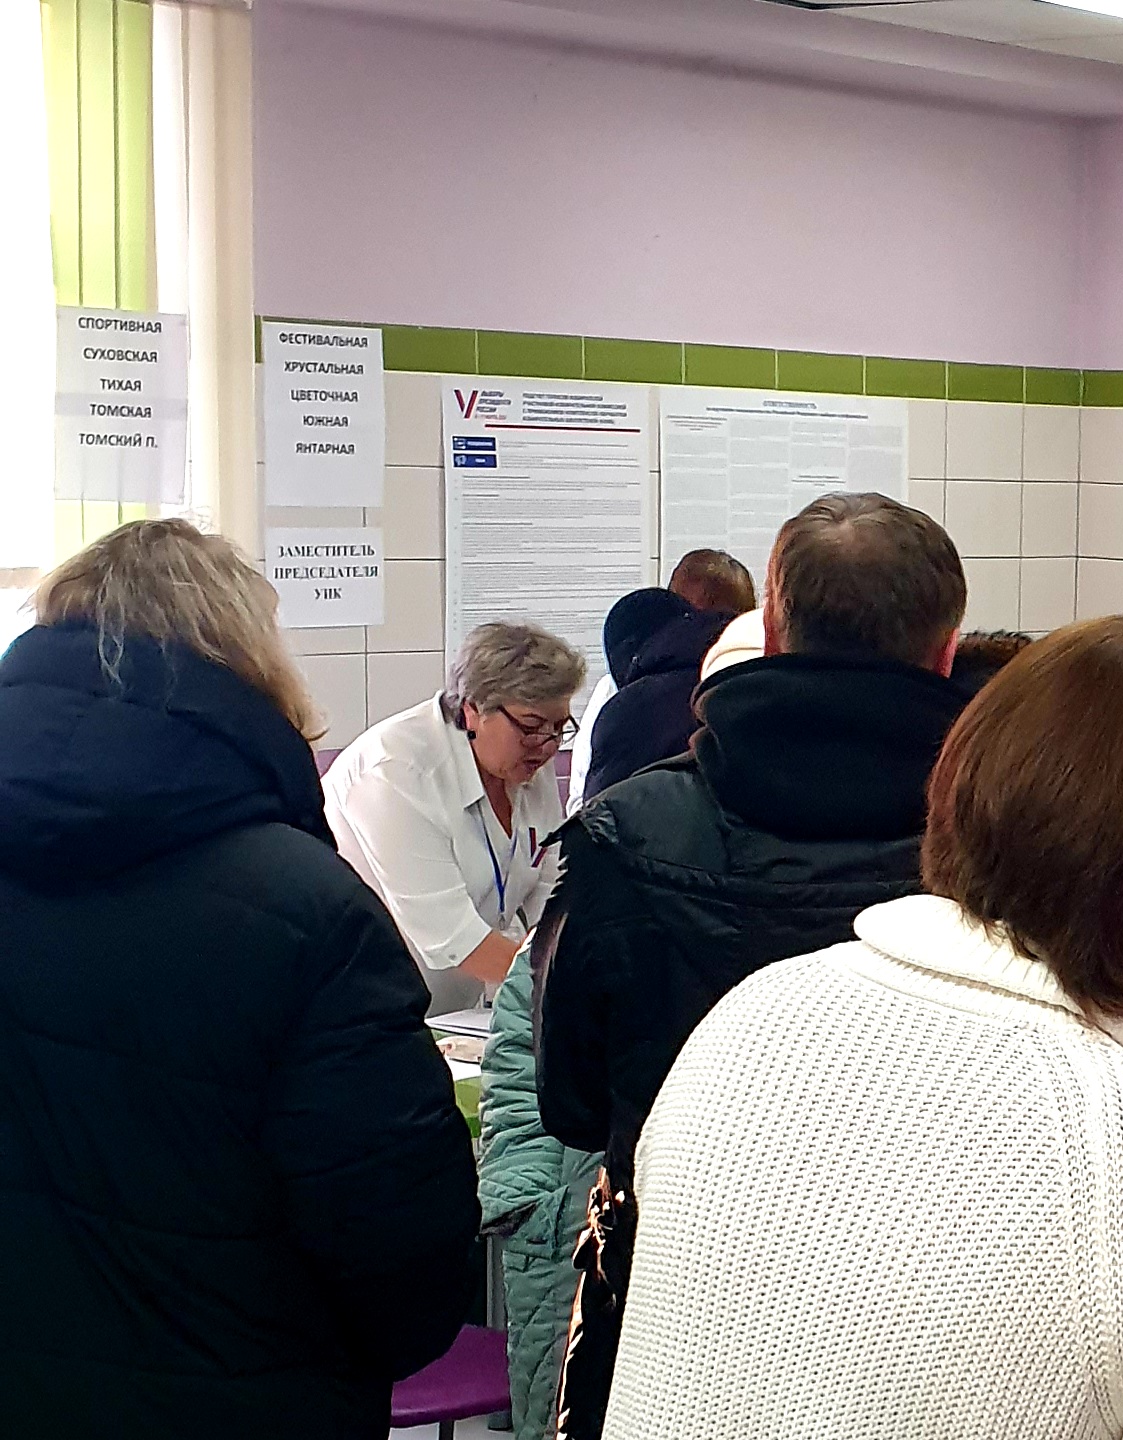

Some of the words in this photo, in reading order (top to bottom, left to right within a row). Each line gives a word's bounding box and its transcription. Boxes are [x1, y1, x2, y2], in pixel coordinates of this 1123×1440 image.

[78, 317, 162, 333] СПОРТИВНАЯ
[279, 333, 368, 348] ФЕСТИВАЛЬНАЯ
[83, 347, 157, 363] СУХОВСКАЯ
[284, 361, 364, 375] ХРУСТАЛЬНАЯ
[100, 378, 142, 392] ТИХАЯ
[290, 389, 358, 402] ЦВЕТОЧНАЯ
[90, 404, 152, 418] ТОМСКАЯ
[303, 415, 349, 427] ЮЖНАЯ
[79, 432, 142, 447] ТОМСКИЙ
[145, 436, 158, 448] П.
[295, 443, 355, 455] ЯНТАРНАЯ
[279, 545, 375, 557] ЗАМЕСТИТЕЛЬ
[274, 566, 379, 580] ПРЕДСЕДАТЕЛЯ
[314, 587, 342, 600] УИК
